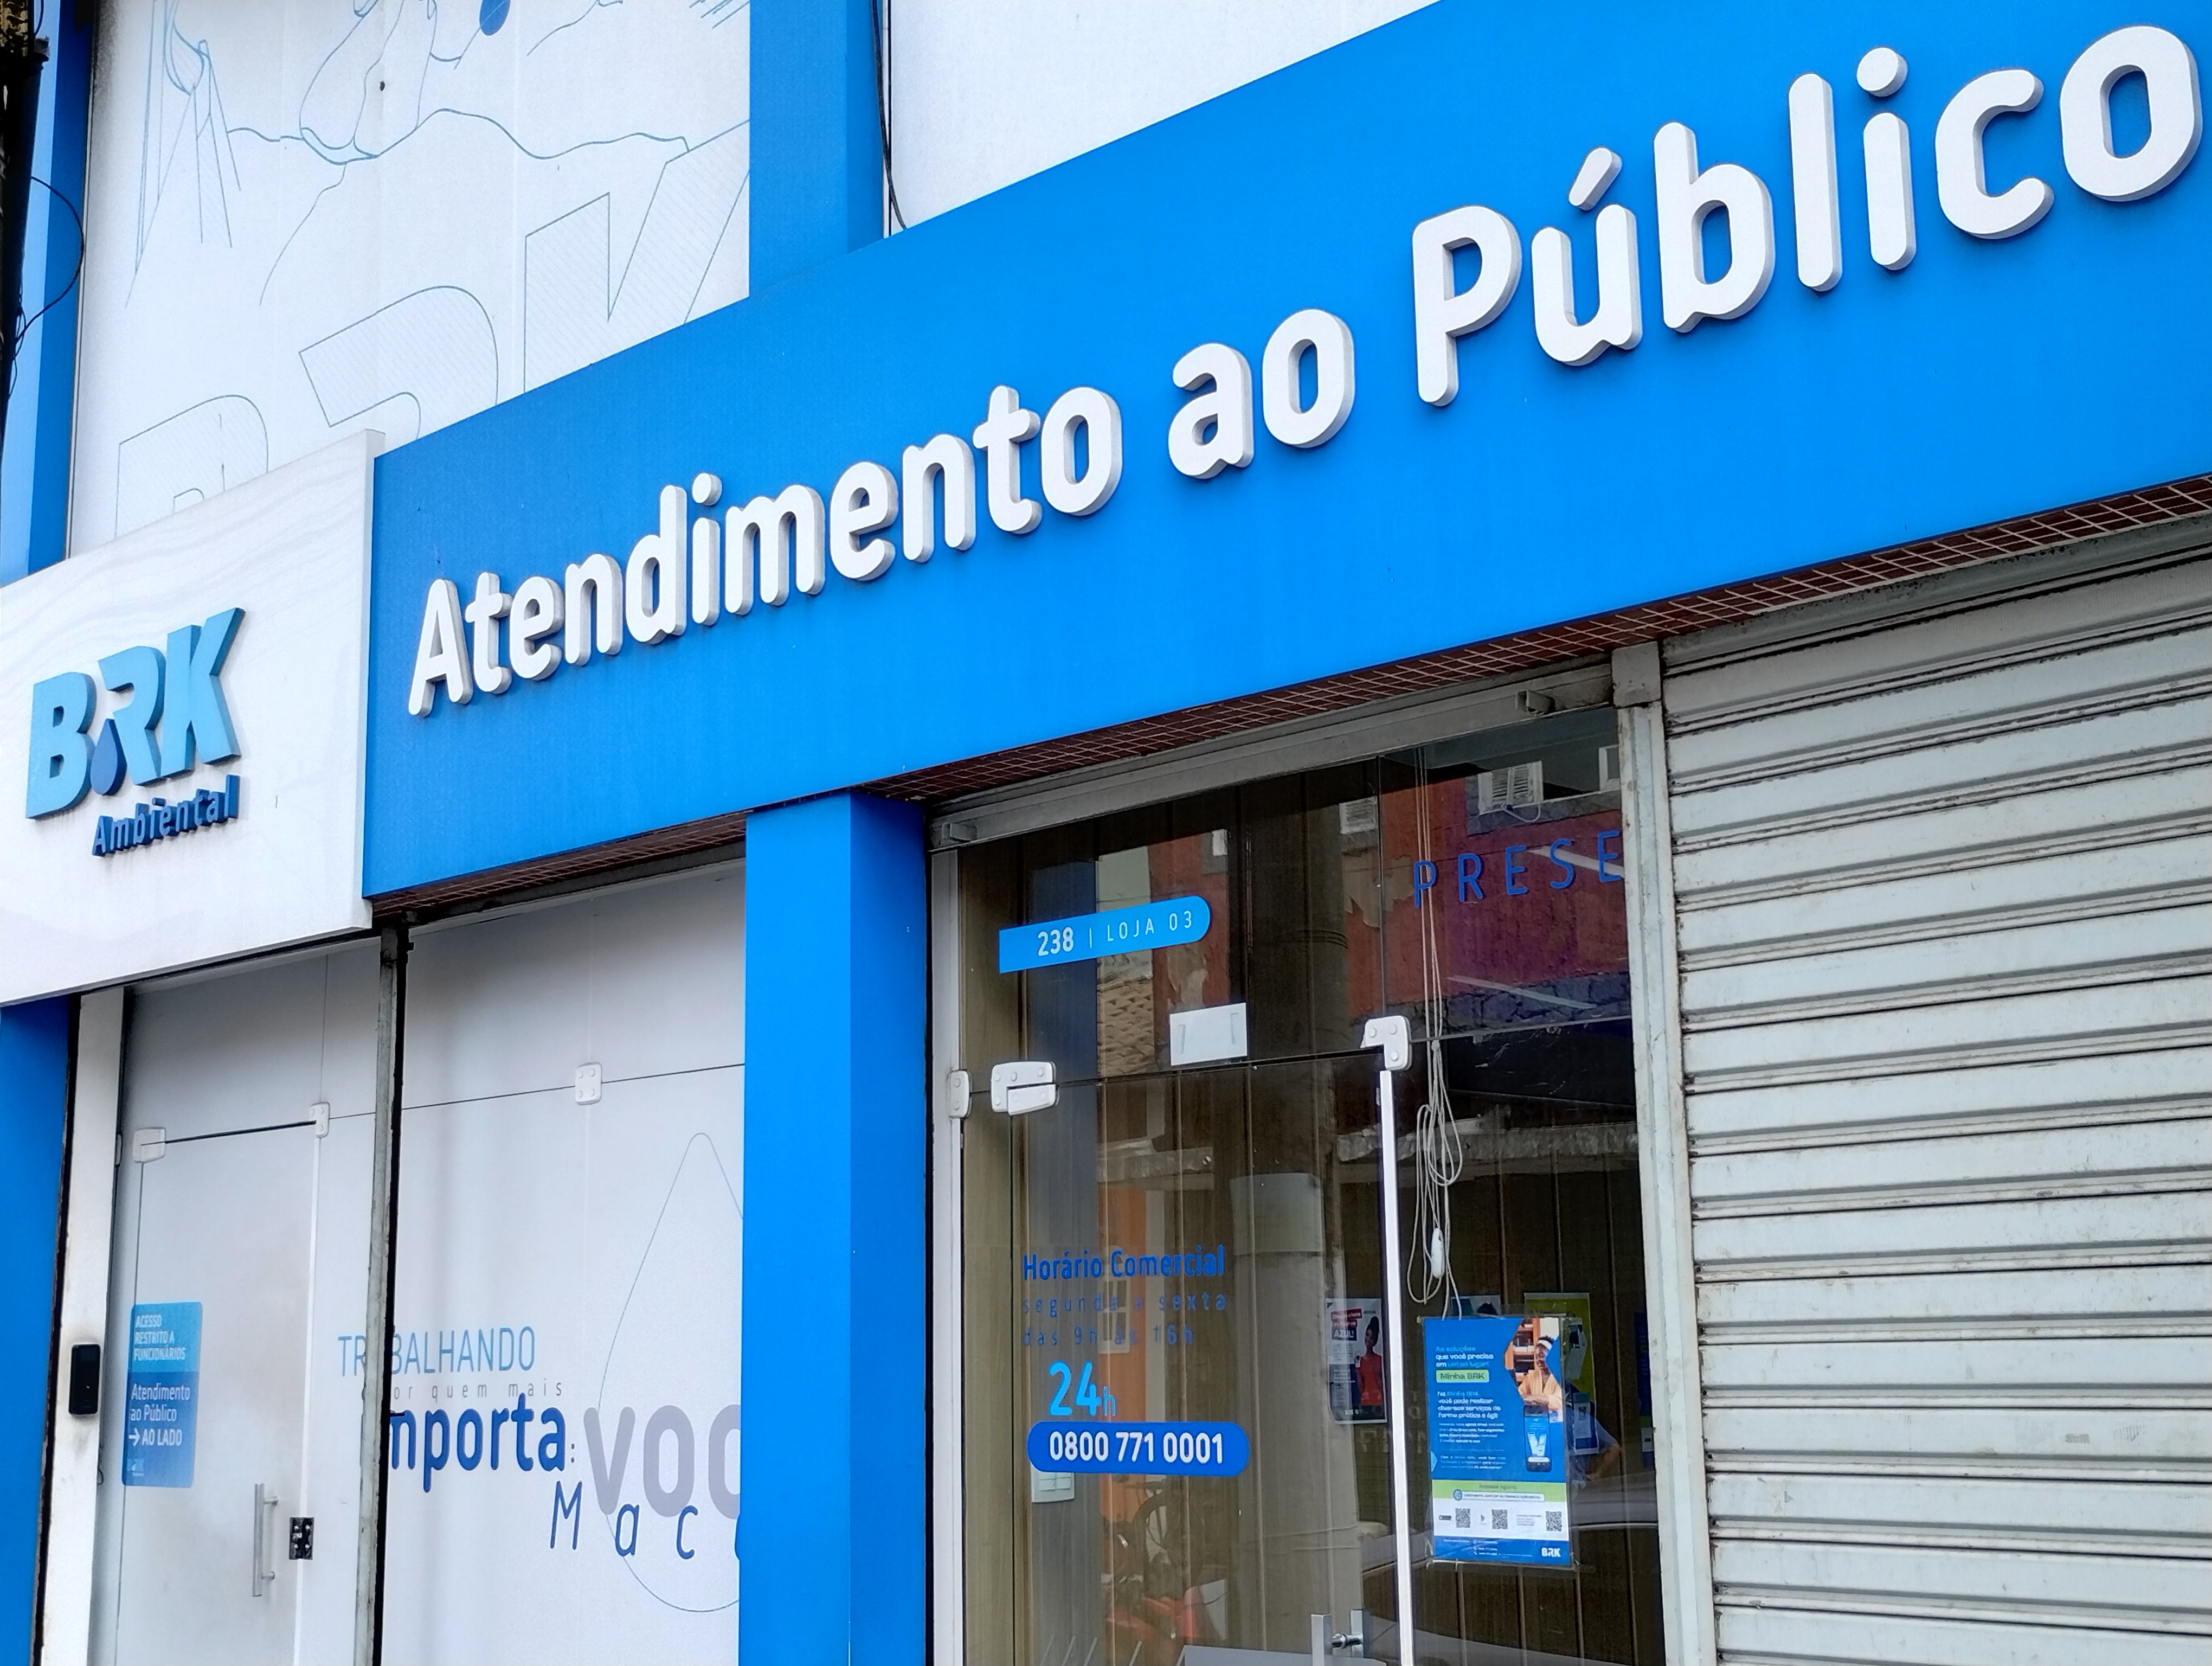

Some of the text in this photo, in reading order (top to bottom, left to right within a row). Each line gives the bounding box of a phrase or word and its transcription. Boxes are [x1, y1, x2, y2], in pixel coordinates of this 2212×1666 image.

[408, 385, 1123, 717] Atendimento
[1168, 307, 1355, 479] ao
[1412, 24, 2203, 407] Público
[26, 607, 246, 819] BRK
[91, 774, 240, 857] Ambiental
[1413, 829, 1622, 908] PRESE
[1037, 910, 1192, 957] 238 LOJA 03
[1023, 1244, 1224, 1280] Horário Comercial
[134, 1314, 162, 1328] ACESSO
[1023, 1292, 1118, 1317] segunda
[1159, 1292, 1225, 1311] sexta
[133, 1330, 175, 1345] RESTRITO A
[338, 1327, 536, 1376] TRBALHANDO
[1023, 1327, 1058, 1346] das
[1074, 1325, 1098, 1345] 9h
[133, 1344, 186, 1361] FUNCIONÁRIOS
[131, 1382, 190, 1400] Atendimento
[394, 1378, 562, 1404] or quem mais
[1048, 1361, 1116, 1416] 24h
[131, 1404, 177, 1422] ao Público
[142, 1428, 183, 1446] AO LADO
[1049, 1431, 1223, 1464] 0800 771 0001
[583, 1404, 741, 1519] voc
[550, 1480, 740, 1560] Mac
[1541, 1547, 1561, 1558] BRK
